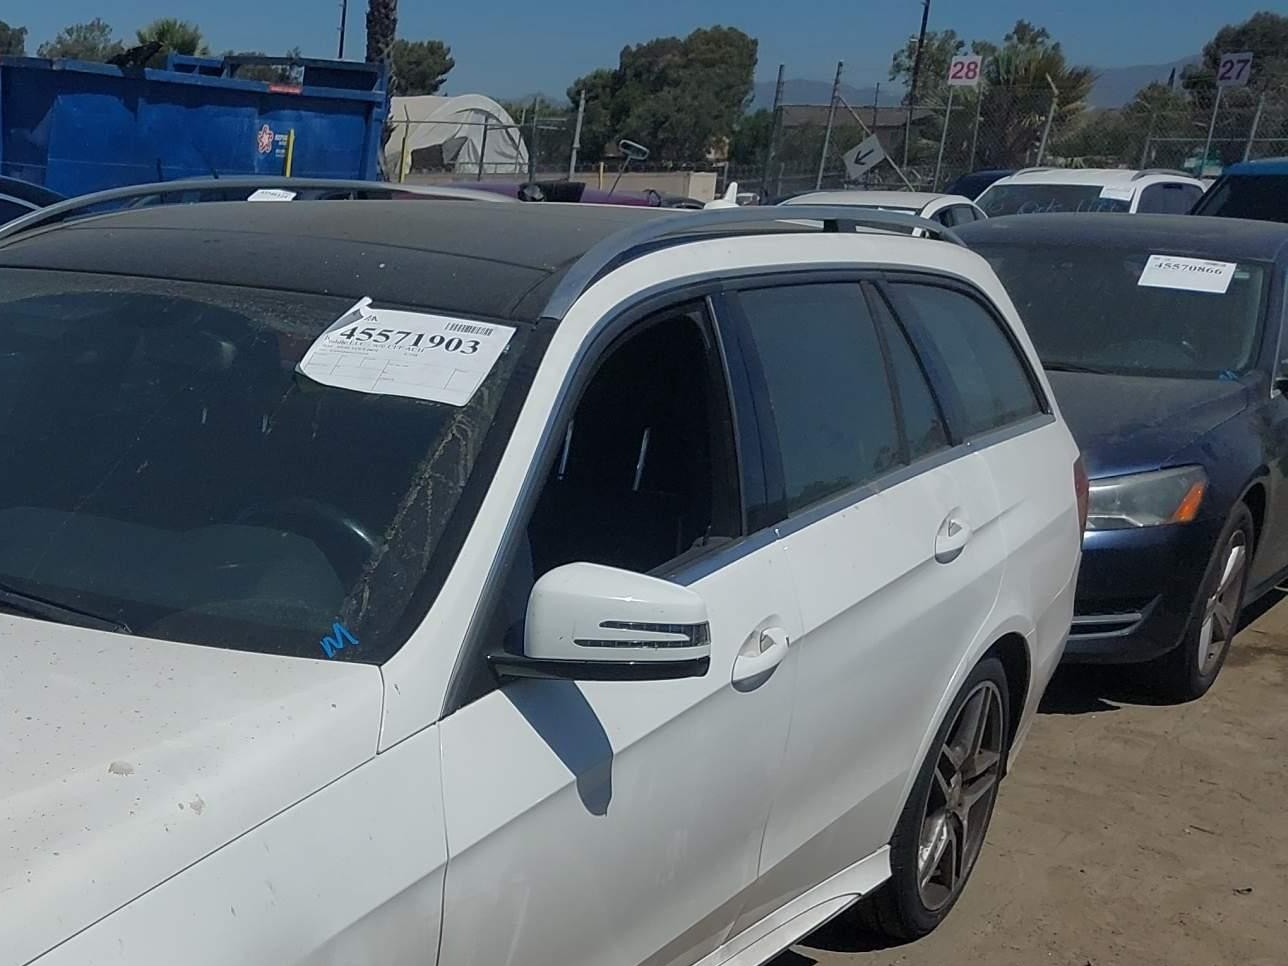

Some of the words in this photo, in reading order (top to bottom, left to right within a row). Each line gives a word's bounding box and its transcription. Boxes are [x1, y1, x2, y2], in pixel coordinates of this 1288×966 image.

[951, 61, 978, 80] 28
[1219, 59, 1251, 80] 27
[340, 326, 481, 355] 45571903
